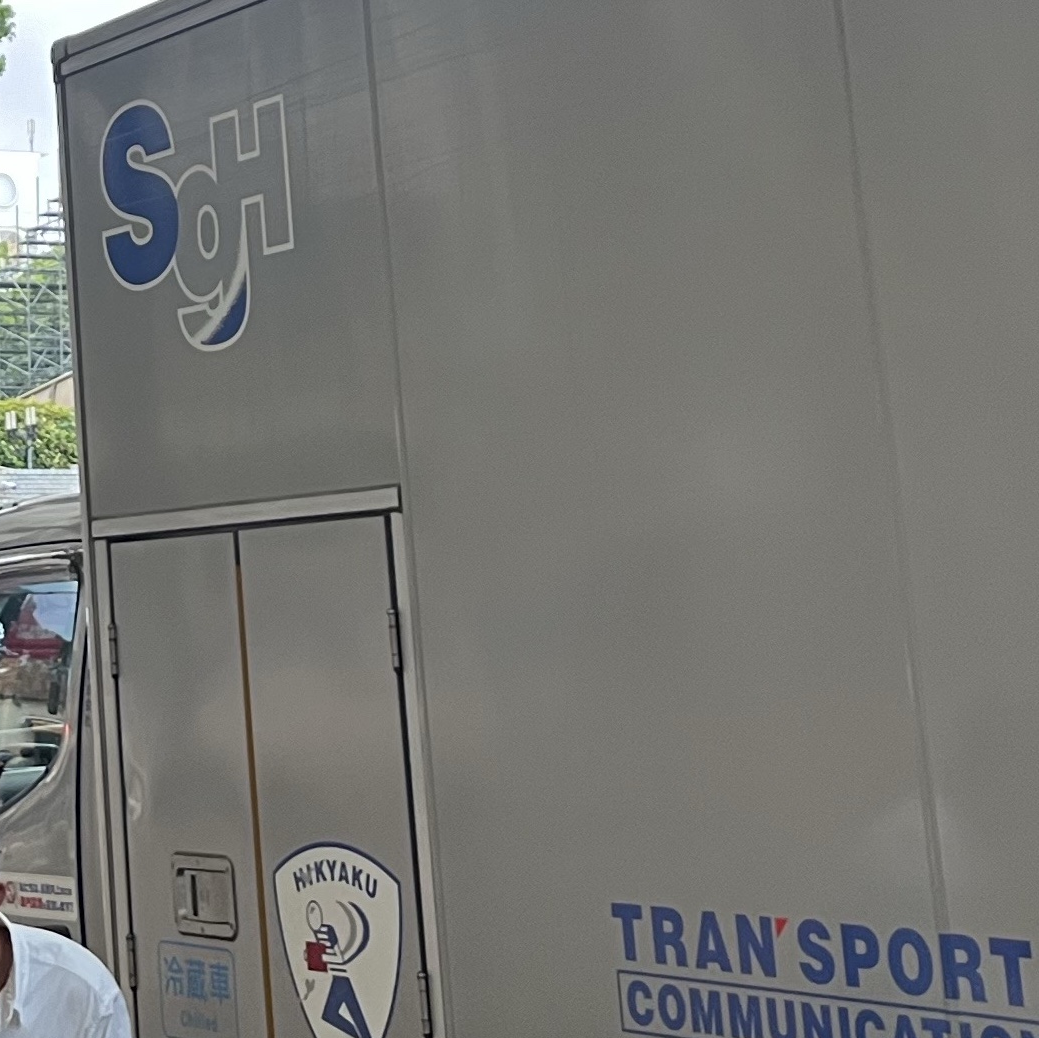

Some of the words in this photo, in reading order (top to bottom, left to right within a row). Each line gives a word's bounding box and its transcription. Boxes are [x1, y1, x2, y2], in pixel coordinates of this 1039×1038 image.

[293, 859, 378, 899] HIKYAKU
[163, 956, 232, 1006] 冷蔵車
